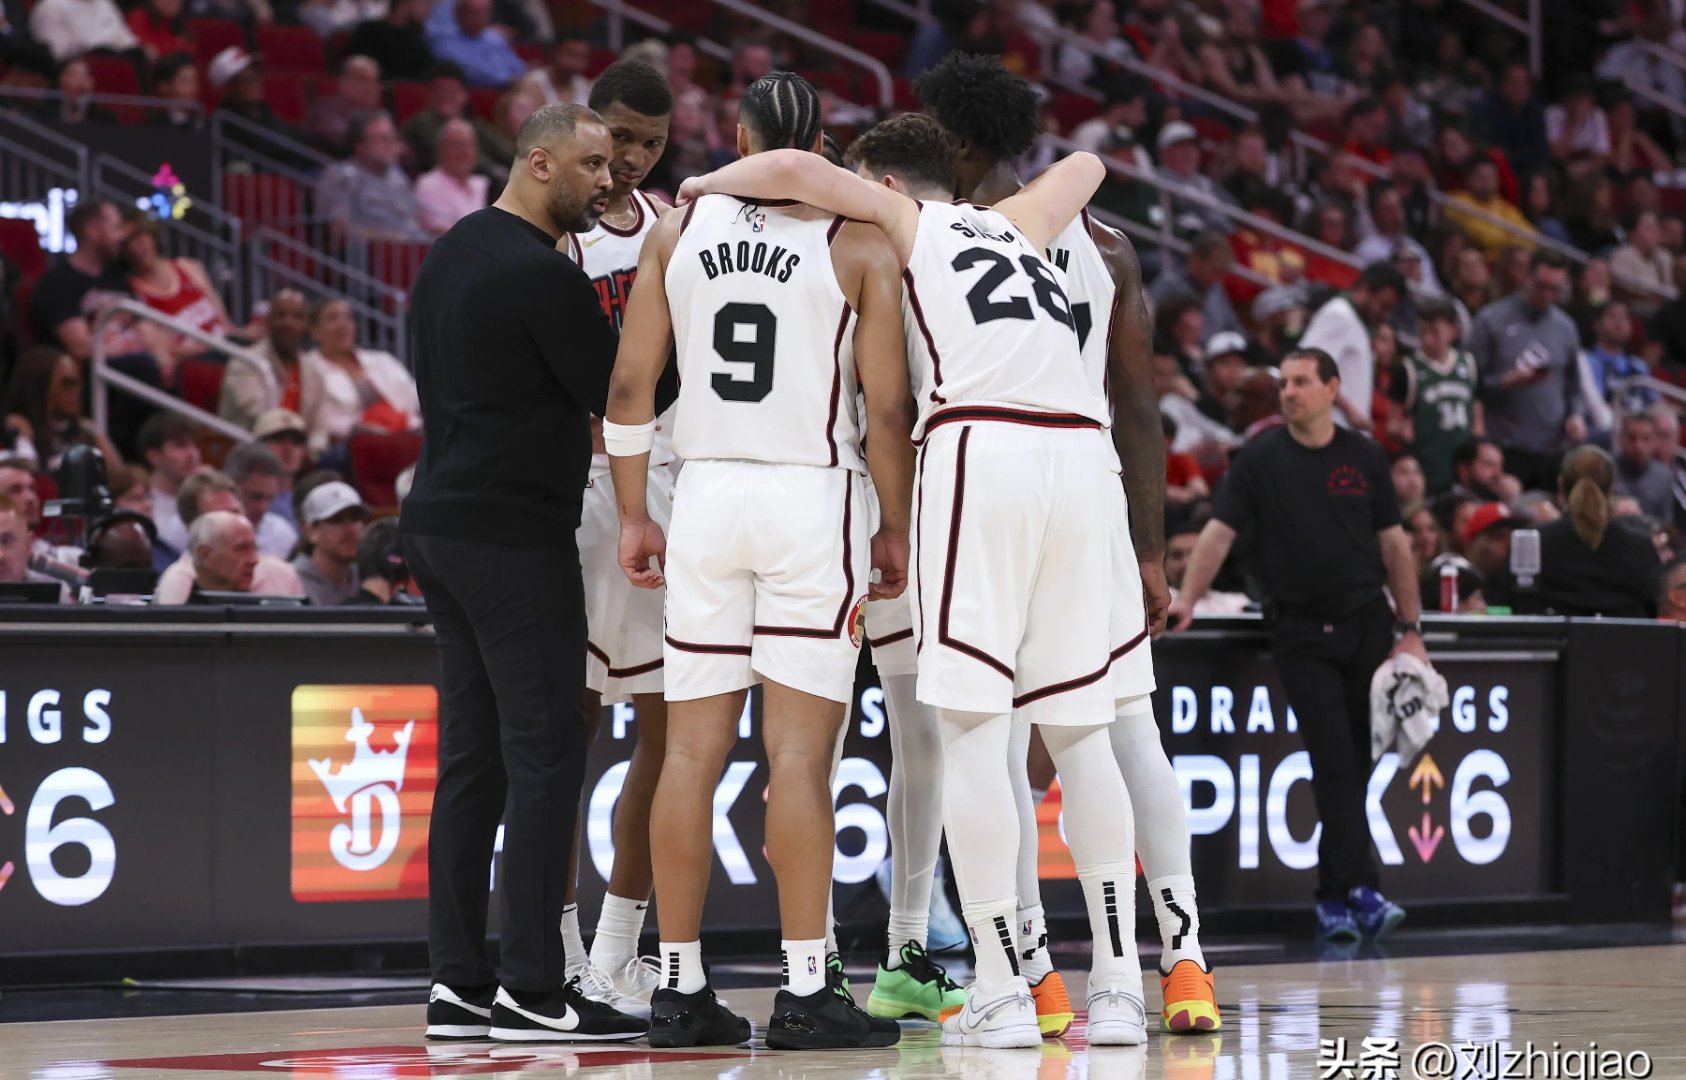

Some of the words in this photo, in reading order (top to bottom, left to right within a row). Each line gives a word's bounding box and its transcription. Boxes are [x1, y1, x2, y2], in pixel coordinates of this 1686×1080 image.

[699, 240, 801, 283] BROOKS
[951, 246, 1076, 334] 28
[710, 302, 778, 403] 9
[25, 766, 117, 906] 6
[832, 757, 888, 884] 6
[1450, 749, 1512, 866] 6
